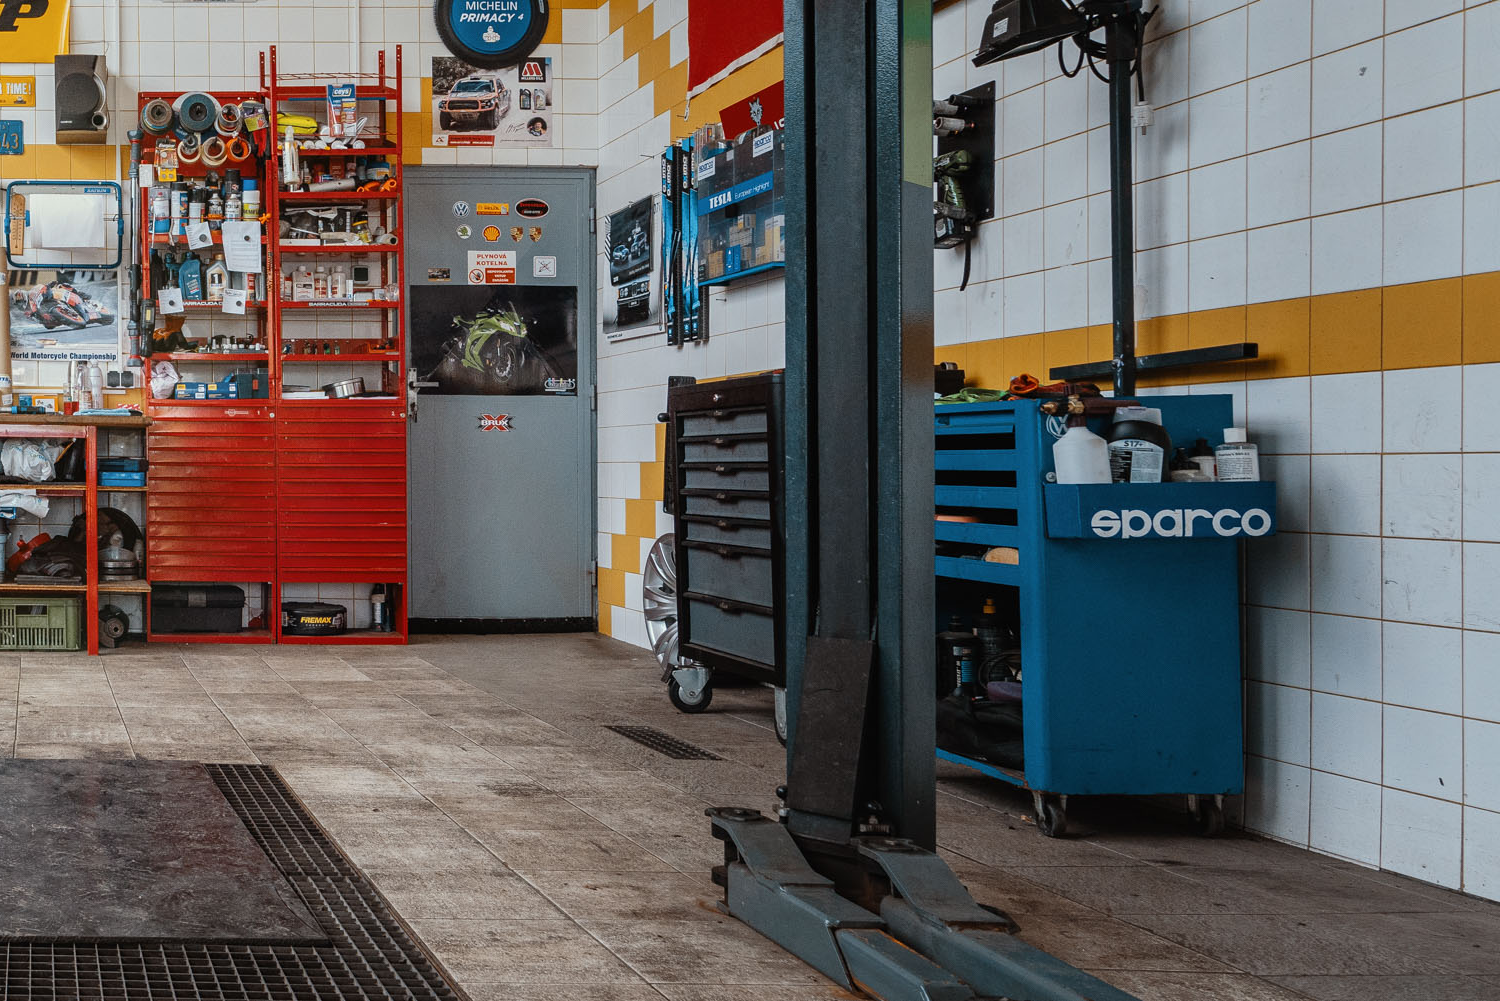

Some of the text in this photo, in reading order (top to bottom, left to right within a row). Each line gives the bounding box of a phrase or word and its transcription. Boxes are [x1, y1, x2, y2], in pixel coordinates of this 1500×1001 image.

[466, 1, 518, 11] MICHELIN
[460, 13, 515, 22] PRIMACY
[6, 83, 32, 95] TIME!
[709, 191, 732, 209] TESLA
[31, 352, 68, 360] Motorcycle
[1091, 508, 1272, 539] sparco
